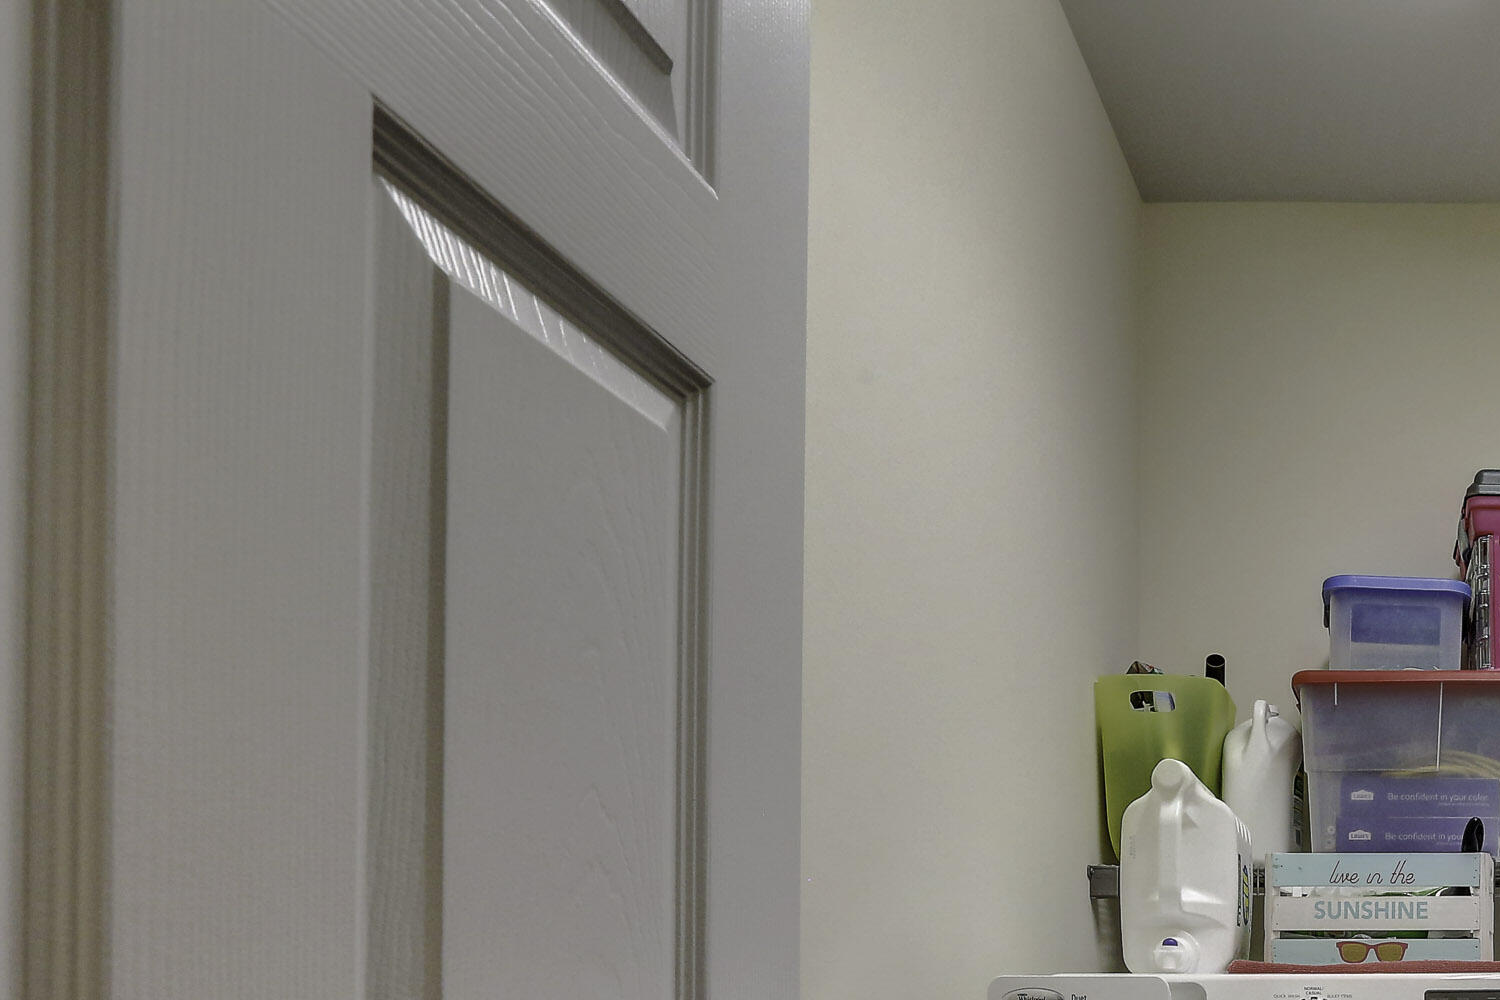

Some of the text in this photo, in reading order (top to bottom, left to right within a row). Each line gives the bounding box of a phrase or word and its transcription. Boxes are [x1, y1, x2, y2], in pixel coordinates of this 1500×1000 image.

[1387, 792, 1399, 801] Be
[1400, 792, 1439, 801] confident
[1440, 792, 1447, 801] in
[1449, 794, 1467, 803] your
[1384, 832, 1463, 843] Be confident in you
[1329, 860, 1416, 884] live in the
[1314, 900, 1429, 920] SUNSHINE
